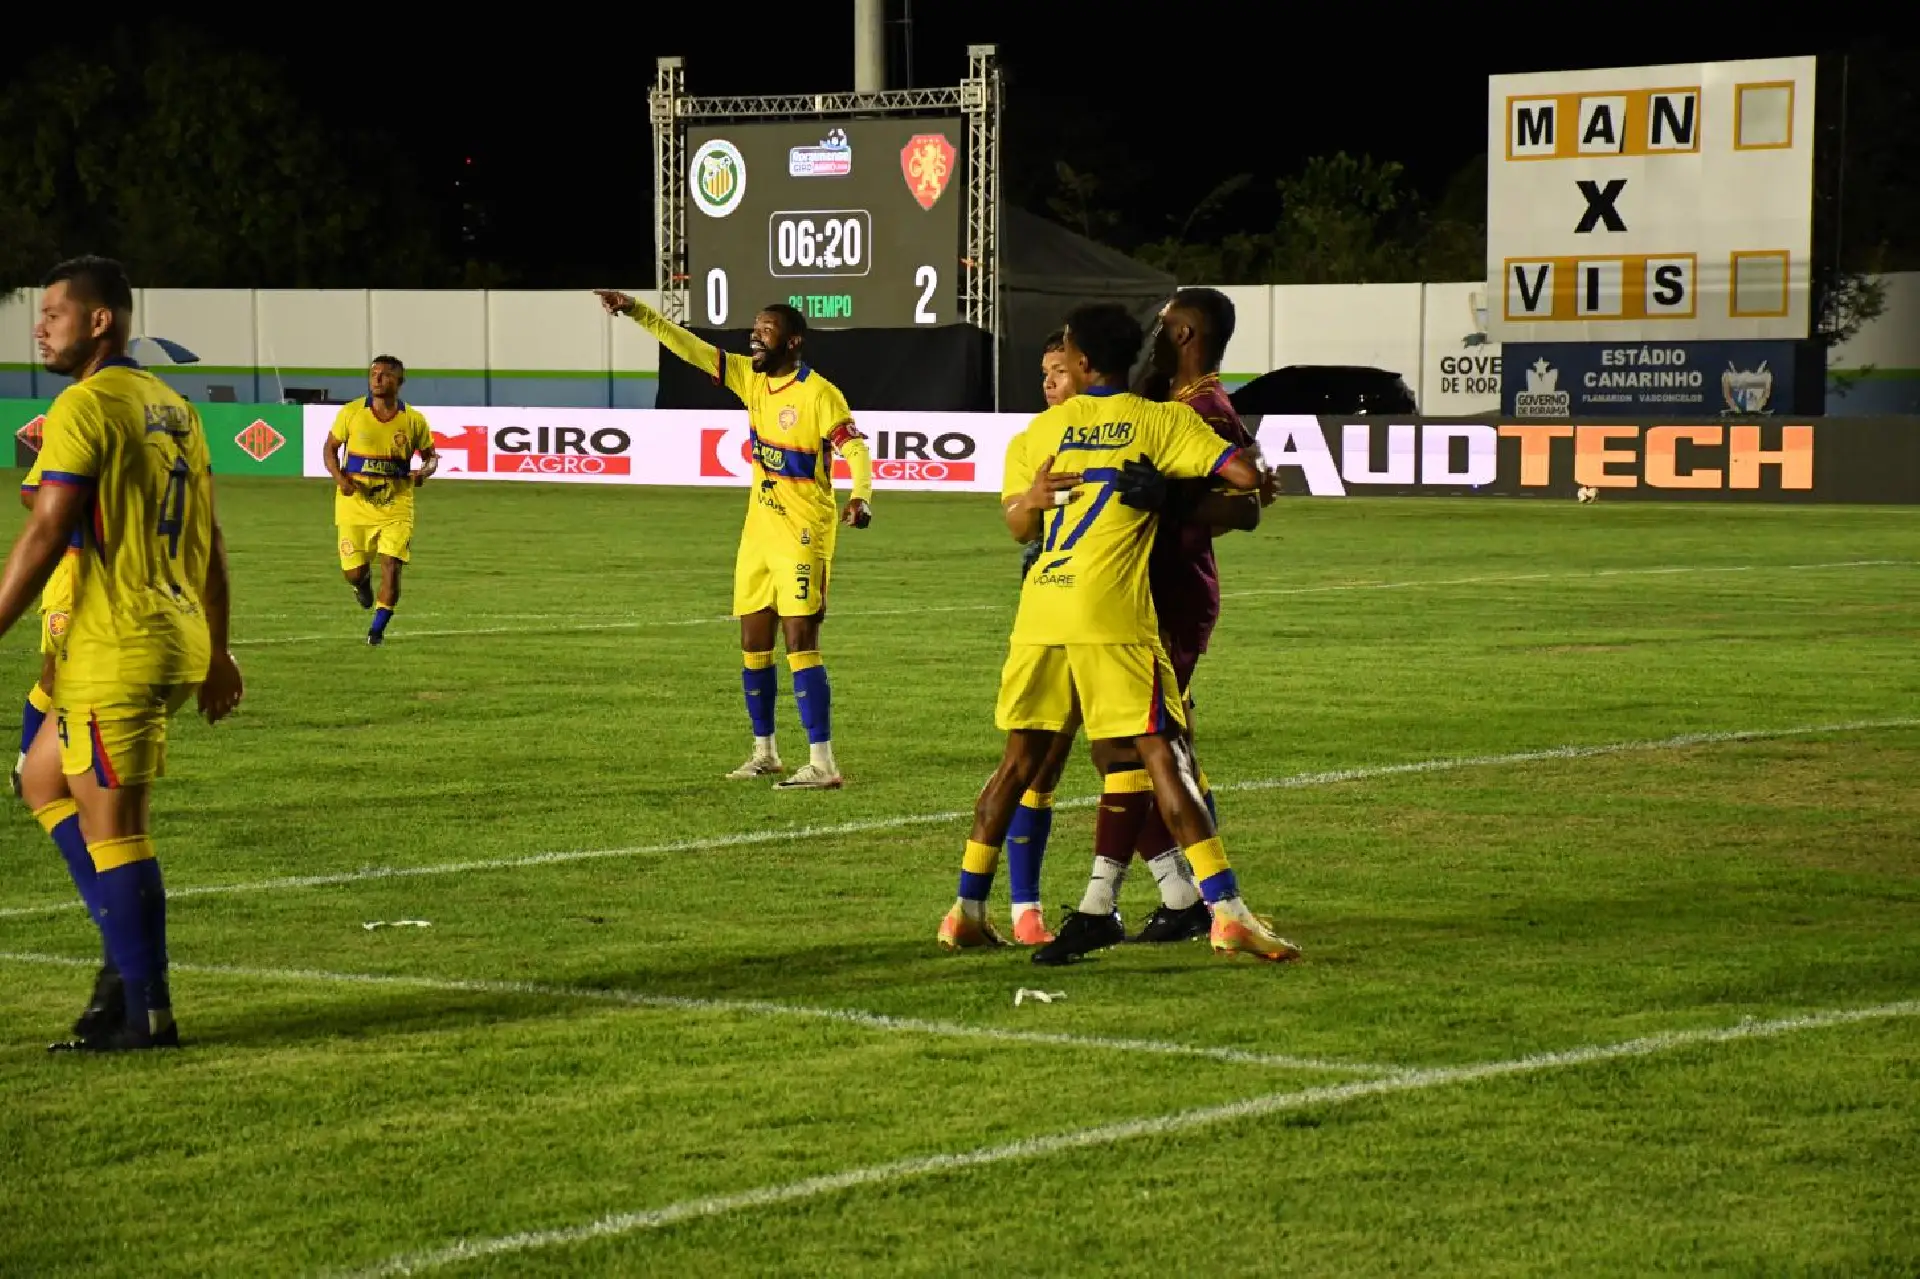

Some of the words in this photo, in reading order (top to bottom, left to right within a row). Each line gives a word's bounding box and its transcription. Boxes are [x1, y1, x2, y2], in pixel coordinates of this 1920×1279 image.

[1517, 96, 1694, 146] MAN
[1574, 179, 1627, 233] X
[779, 219, 860, 267] 06:20
[707, 268, 728, 325] 0
[915, 266, 937, 324] 2
[1514, 265, 1684, 311] VIS
[806, 295, 852, 318] TEMPO
[1602, 346, 1685, 366] ESTÁDIO
[1441, 377, 1460, 393] DE
[1465, 377, 1502, 394] ROR
[1583, 371, 1703, 388] CANARINHO
[494, 426, 631, 455] GIRO
[877, 431, 976, 461] IRO
[1061, 422, 1133, 445] ASATUR
[516, 456, 606, 473] AGRO
[871, 461, 949, 481] GRO
[157, 456, 188, 560] 4
[795, 577, 810, 600] 3
[1033, 574, 1076, 588] VOARE
